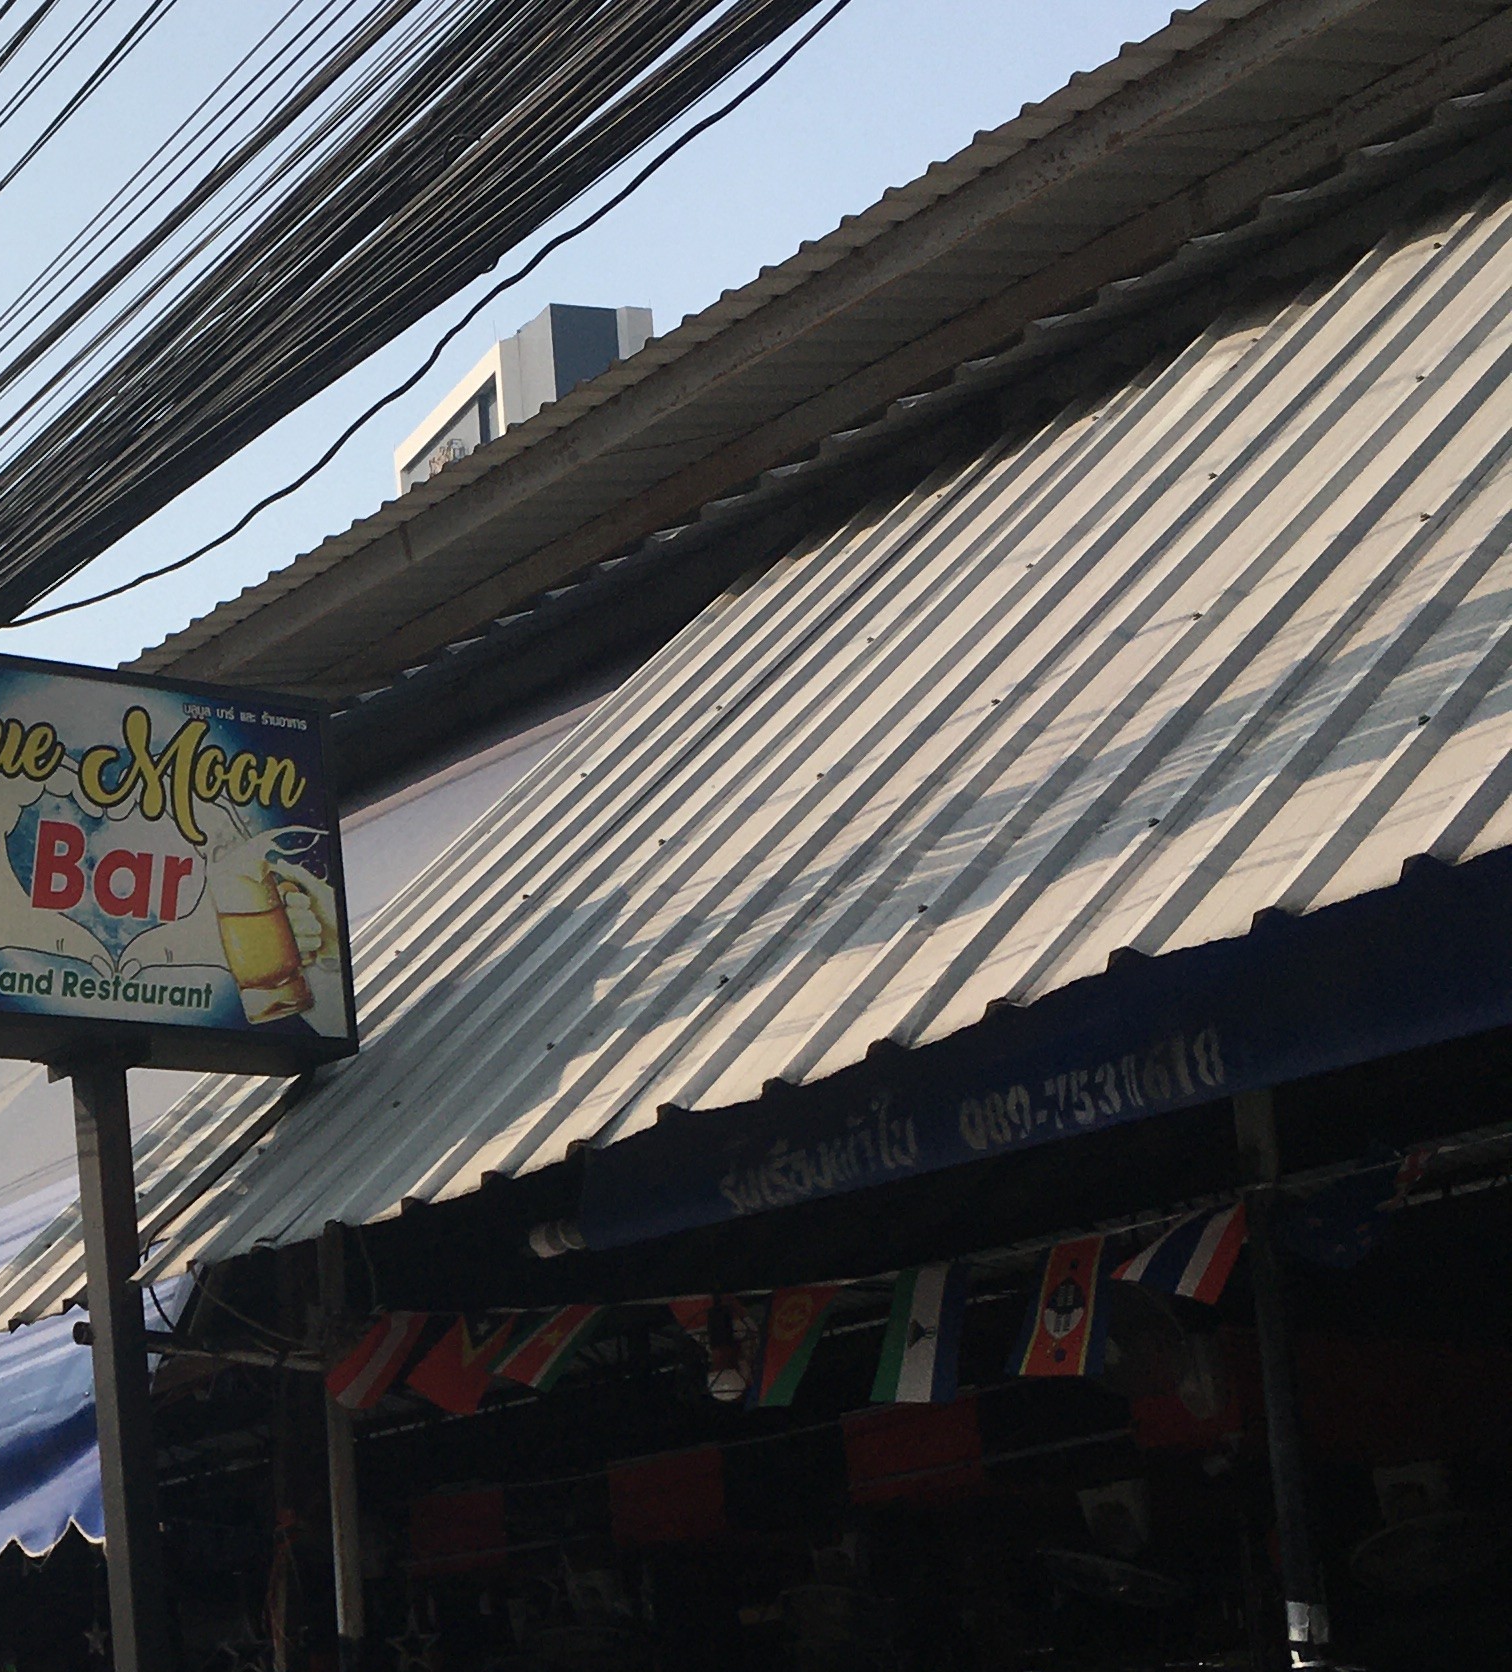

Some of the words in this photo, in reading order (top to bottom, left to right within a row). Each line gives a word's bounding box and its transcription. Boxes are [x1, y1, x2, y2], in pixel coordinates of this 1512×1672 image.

[77, 705, 306, 846] Moon
[31, 820, 194, 922] Bar
[62, 971, 213, 1010] Restaurant
